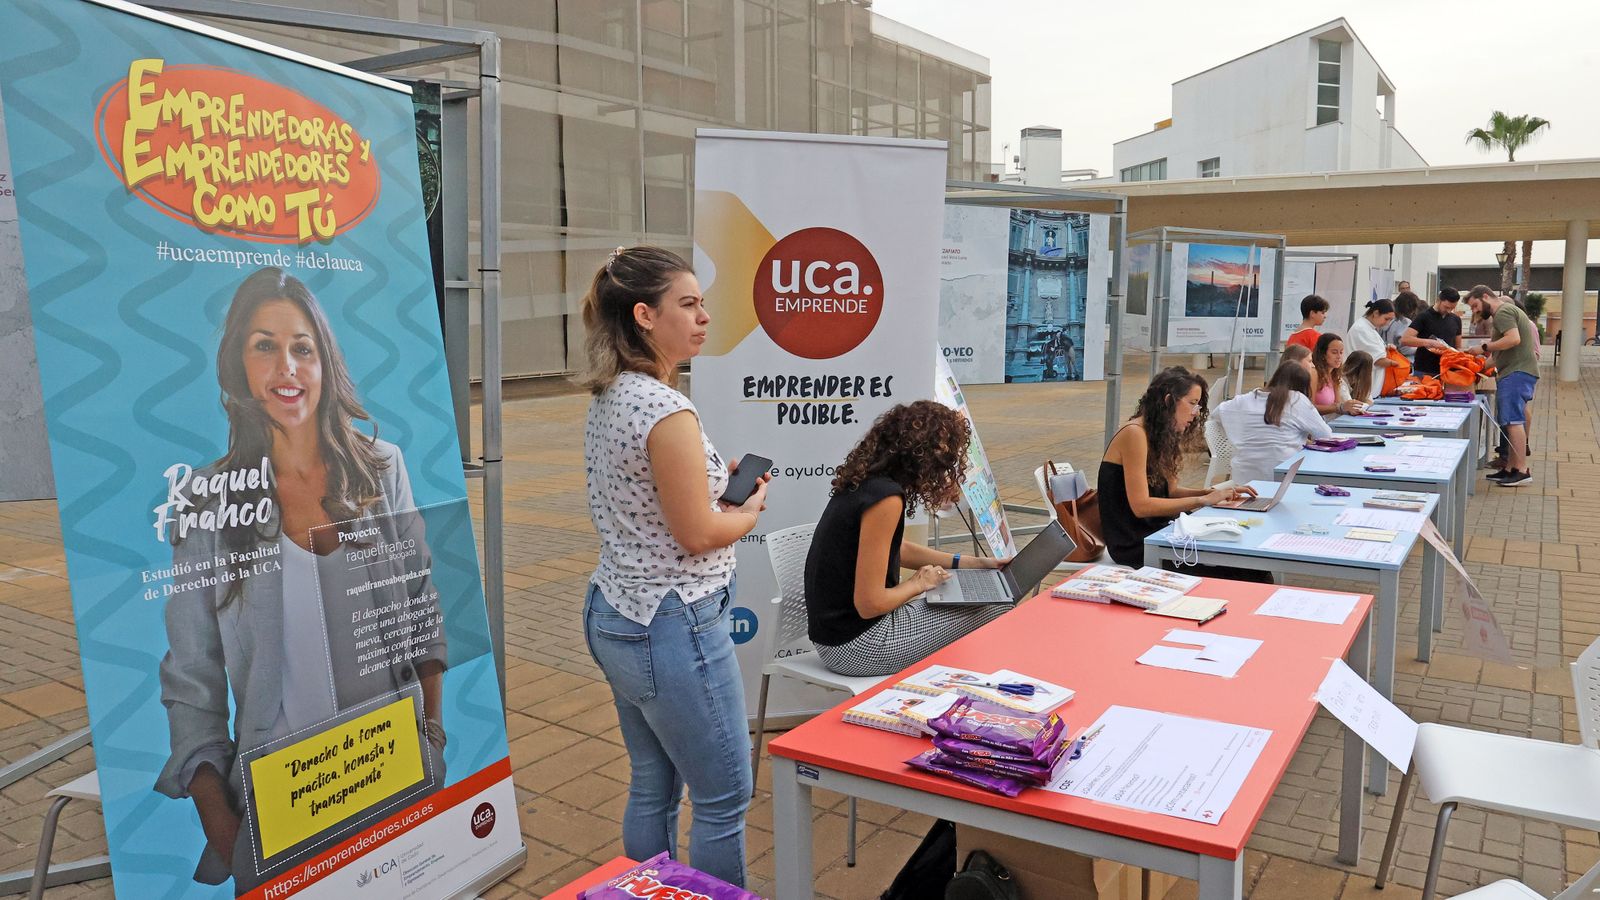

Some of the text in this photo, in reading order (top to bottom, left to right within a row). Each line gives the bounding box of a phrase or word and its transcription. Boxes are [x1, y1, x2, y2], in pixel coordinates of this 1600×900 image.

[128, 58, 353, 153] EMPRENDEDORAS
[122, 119, 351, 186] EMPRENDEDORES
[193, 182, 337, 240] COMO TÚ
[156, 241, 363, 271] #ucaemprende #delauca
[771, 259, 873, 295] uca.
[775, 297, 868, 314] EMPRENDE
[743, 374, 893, 399] EMPRENDER ES
[777, 402, 858, 425] POSIBLE.
[162, 456, 269, 511] Raquel
[785, 463, 836, 480] ayuda
[153, 497, 273, 542] Franco
[338, 526, 381, 542] Proyecto:
[141, 543, 281, 583] Estudió en la Facultad
[346, 538, 415, 563] raquelfranco
[388, 548, 416, 561] abogada
[144, 560, 282, 601] de Derecho de la UCA
[346, 567, 431, 596] raquelfrancoabogada.com
[352, 590, 438, 623] El despacho donde se
[353, 605, 435, 637] ejerce una abogacía
[355, 614, 443, 650] nueva, cercana y de la
[357, 627, 439, 664] máxima confianza al
[359, 646, 428, 677] alcance de todos.
[342, 734, 354, 750] de
[359, 719, 391, 744] forma
[343, 742, 385, 775] honesta
[388, 739, 395, 755] y
[473, 808, 494, 825] uca.
[263, 803, 434, 900] https://emprendedores.uca.es
[373, 858, 398, 879] UCA
